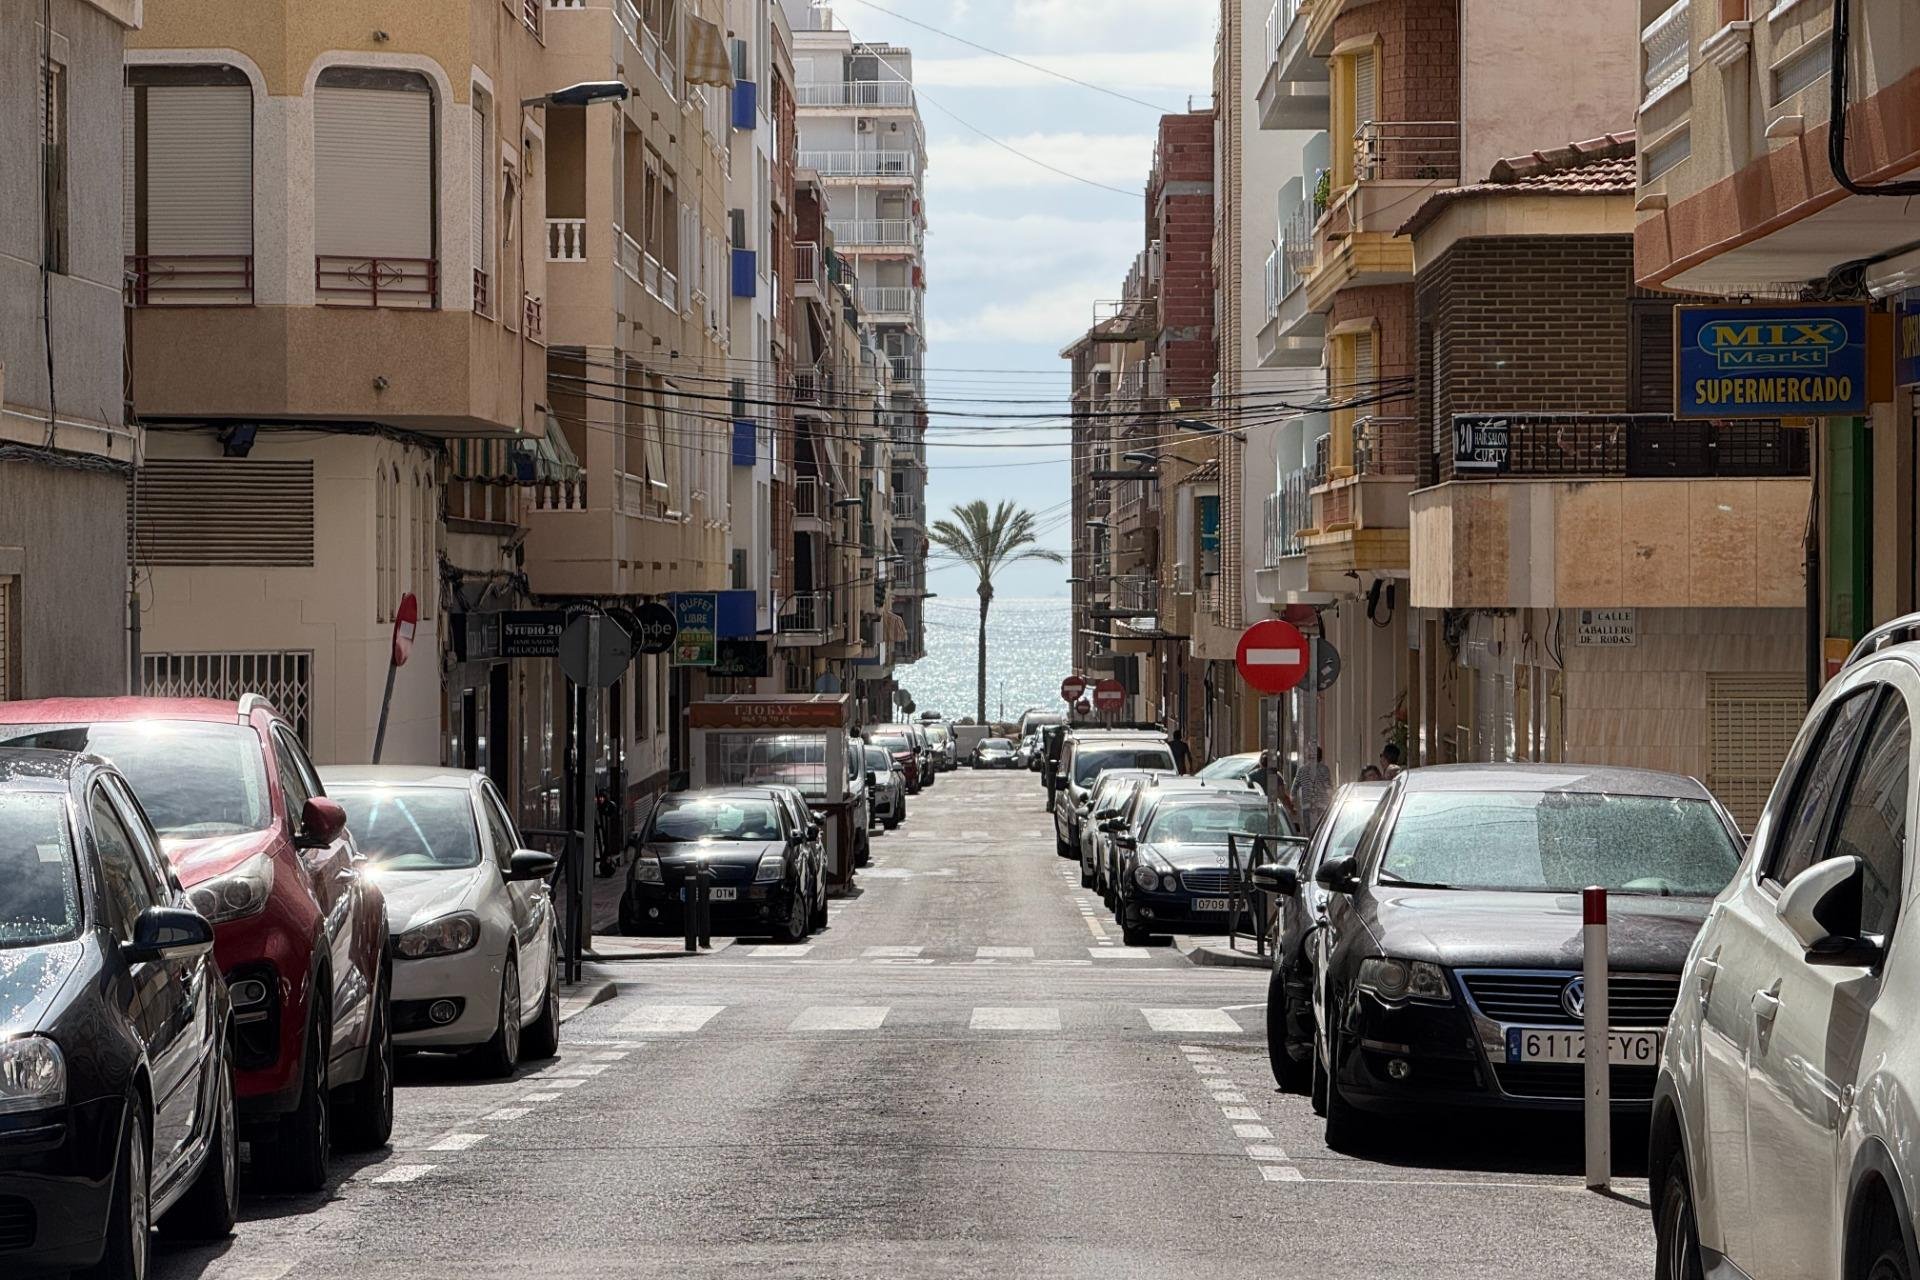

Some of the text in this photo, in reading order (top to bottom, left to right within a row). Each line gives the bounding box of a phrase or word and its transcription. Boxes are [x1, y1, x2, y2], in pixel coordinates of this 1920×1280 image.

[1711, 324, 1834, 346] MIX
[1723, 351, 1823, 363] Markt
[1695, 376, 1852, 404] SUPERMERCADO
[1461, 423, 1472, 454] 20
[1488, 431, 1508, 446] SALON
[1474, 449, 1507, 462] CURLY
[679, 598, 714, 612] BUFFET
[684, 613, 708, 624] LIBRE
[1598, 612, 1631, 621] CALLE
[547, 624, 562, 636] 20
[643, 620, 672, 638] афе
[1579, 626, 1633, 634] CABALLERO
[1580, 635, 1633, 644] DE RODAS
[735, 704, 798, 716] ГЛОБУС
[1198, 900, 1225, 910] 0709
[1527, 1034, 1586, 1058] 6112
